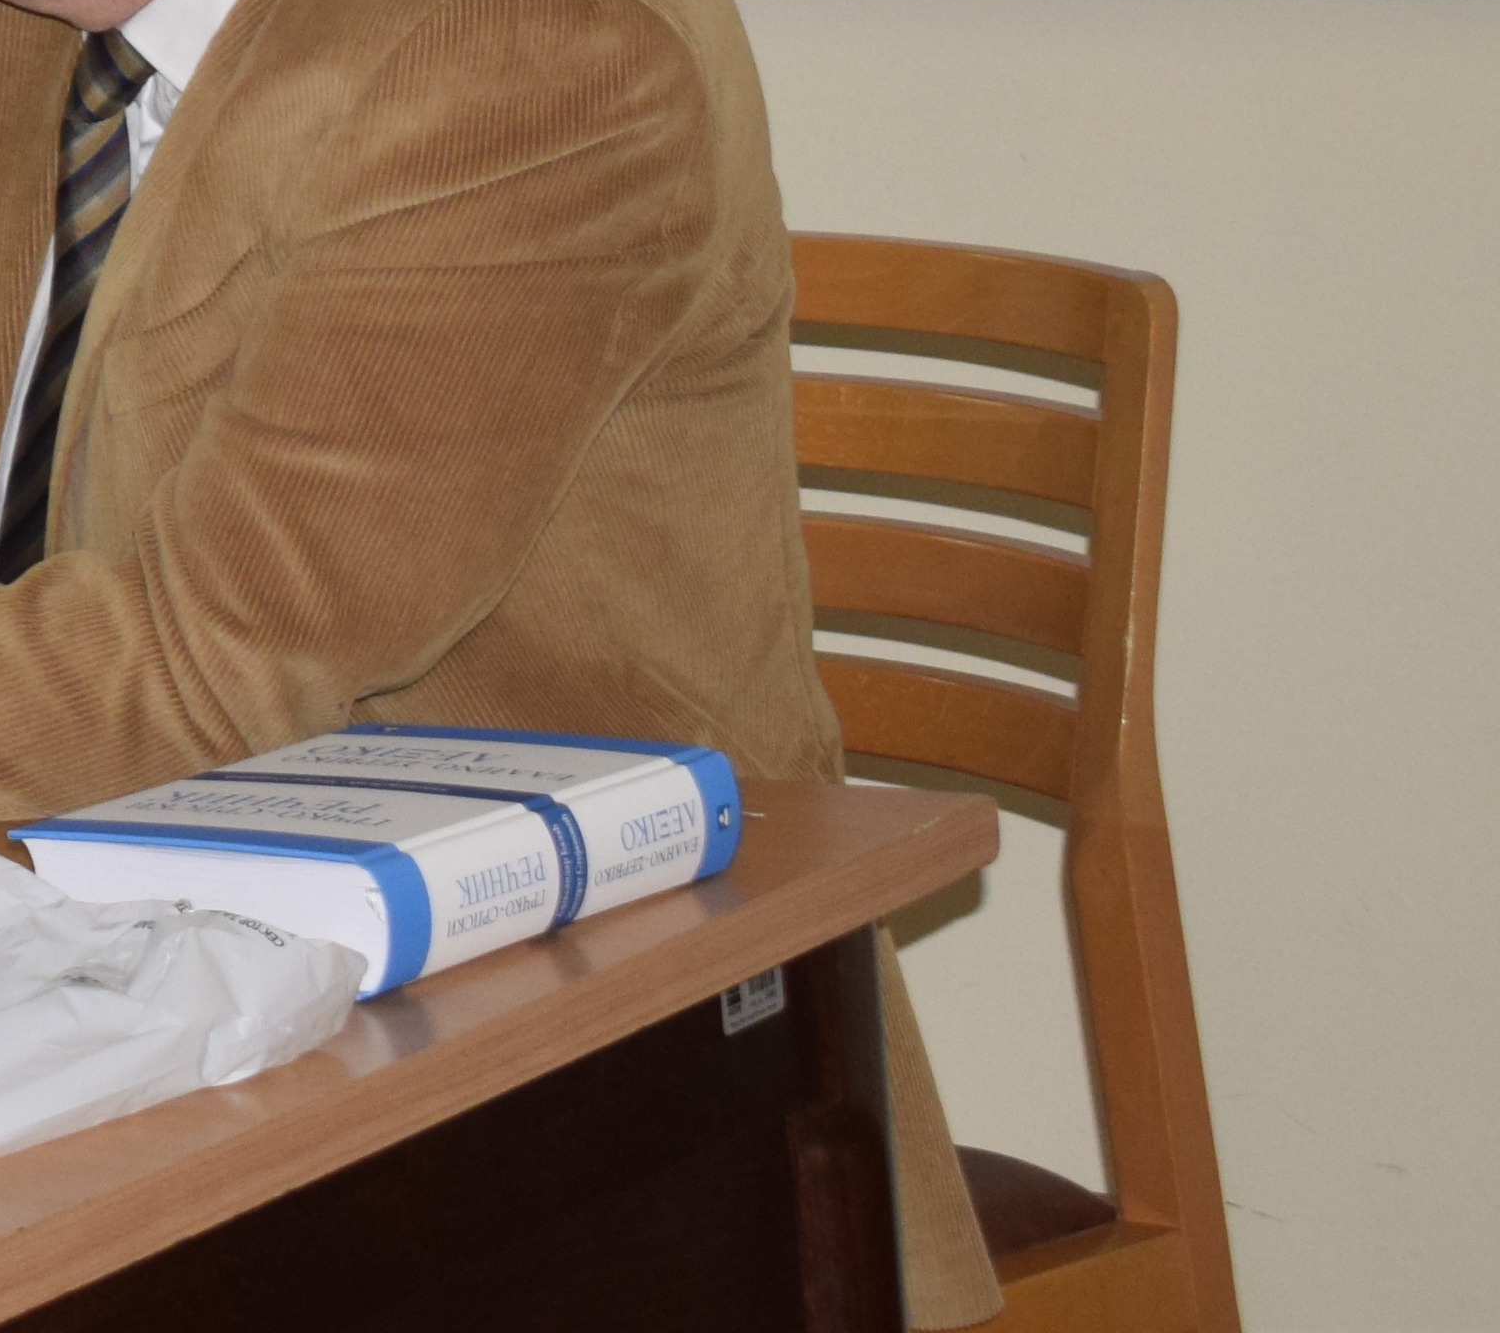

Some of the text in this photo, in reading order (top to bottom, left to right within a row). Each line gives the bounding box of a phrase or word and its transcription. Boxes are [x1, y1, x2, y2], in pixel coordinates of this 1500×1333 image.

[621, 799, 696, 851] ΛΕΞΙΚΟ
[455, 851, 546, 908] РЕЧНИК
[447, 889, 546, 938] ГРЧКО-СРПСКИ
